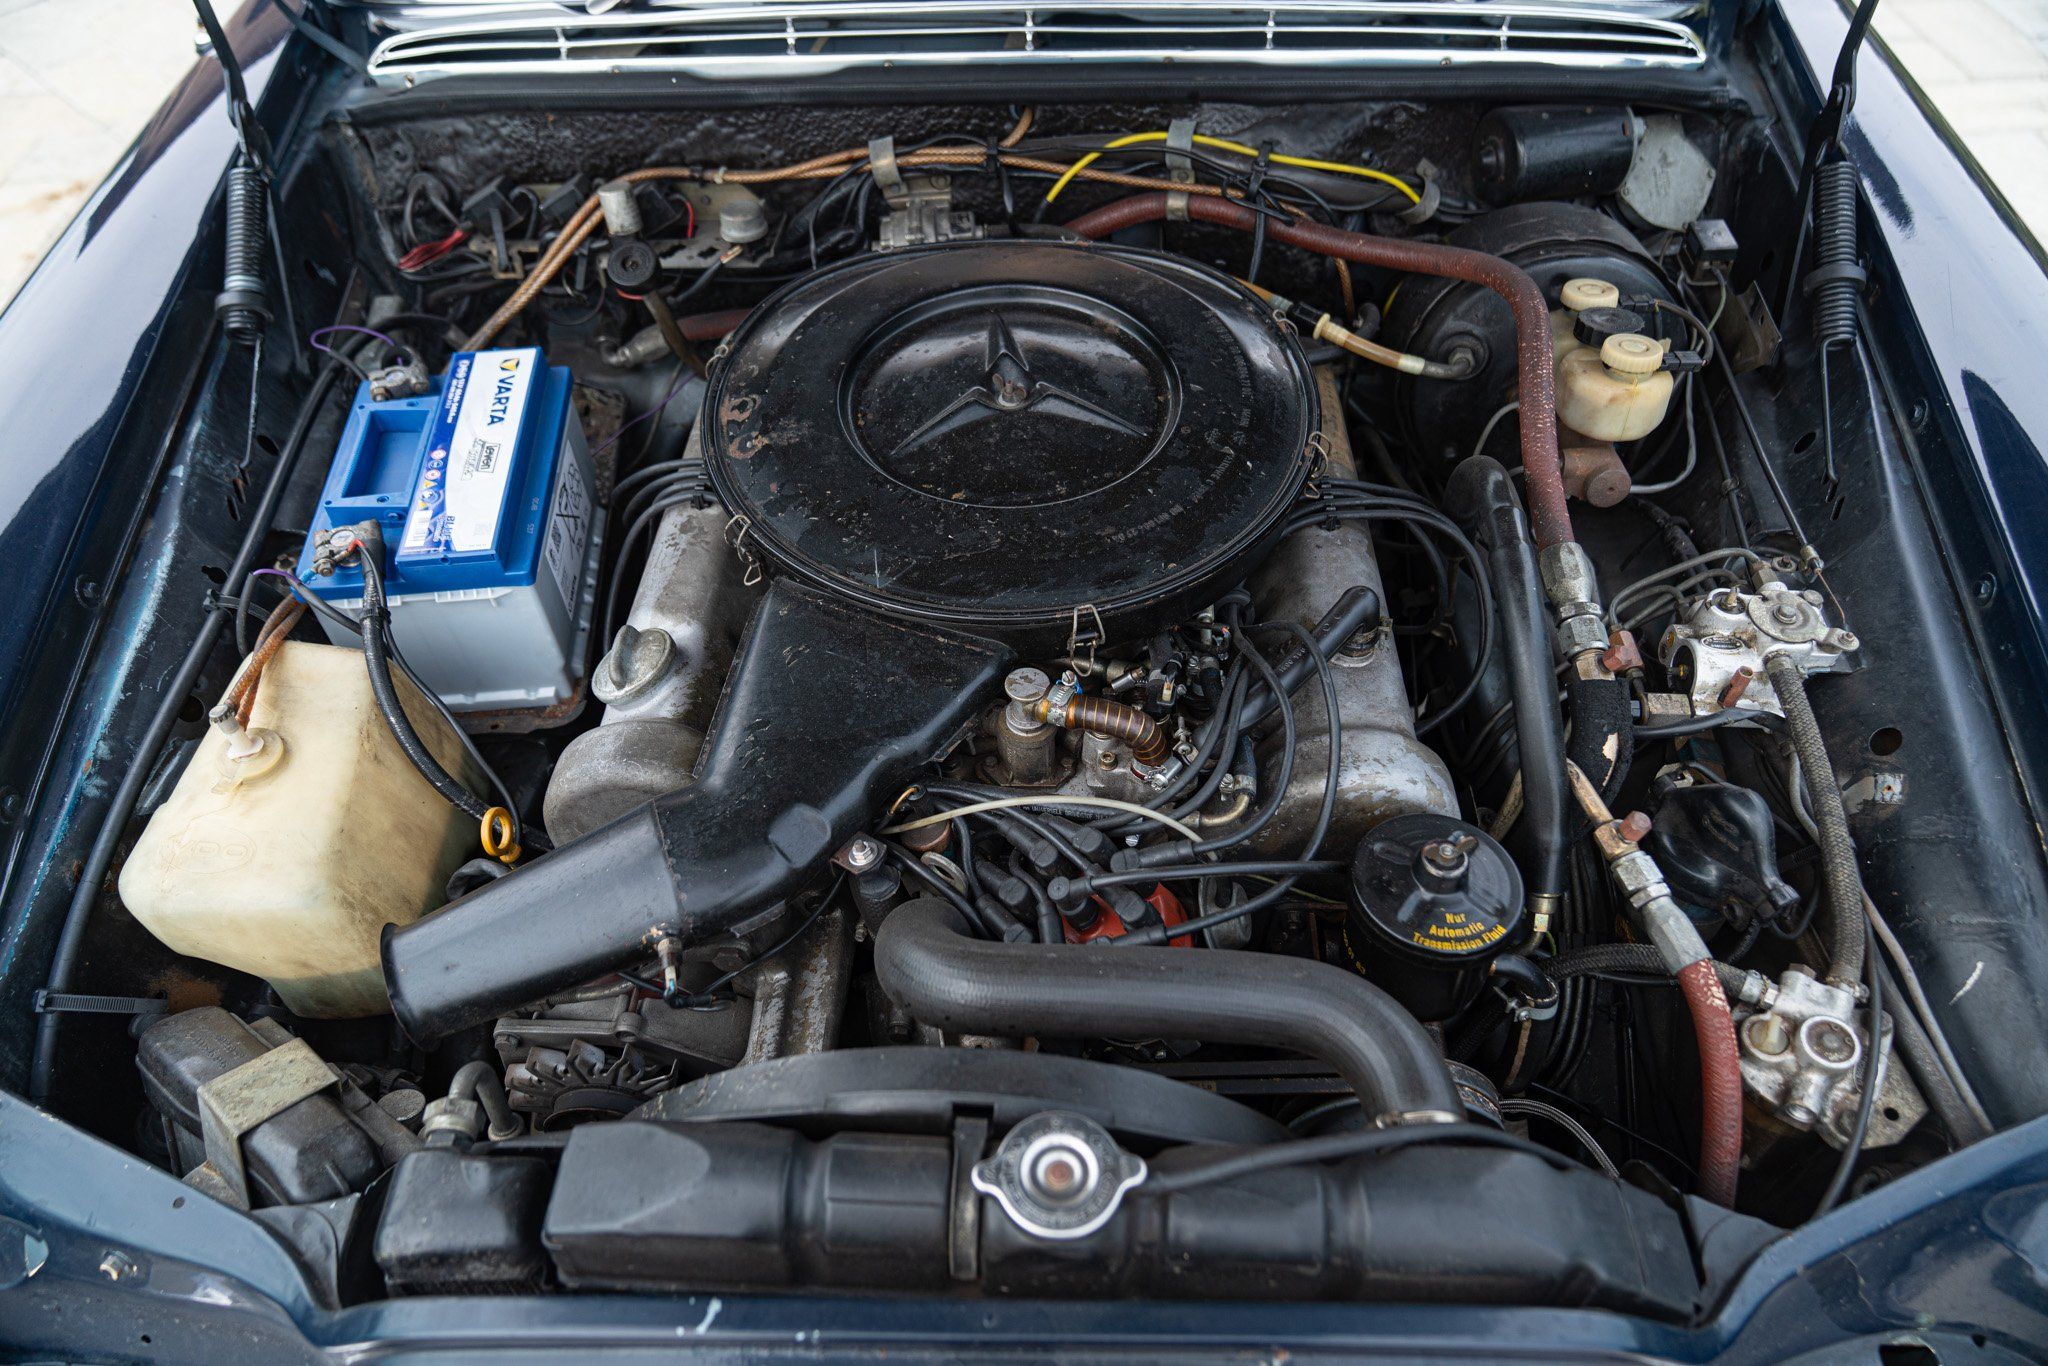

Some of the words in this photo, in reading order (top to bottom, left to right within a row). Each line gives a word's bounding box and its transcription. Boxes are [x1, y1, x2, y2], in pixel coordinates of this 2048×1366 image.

[487, 374, 513, 426] VARTA
[1445, 912, 1466, 924] Nur
[1413, 932, 1483, 950] Transmission
[1483, 925, 1507, 945] Fluid
[1429, 921, 1485, 938] Automatic
